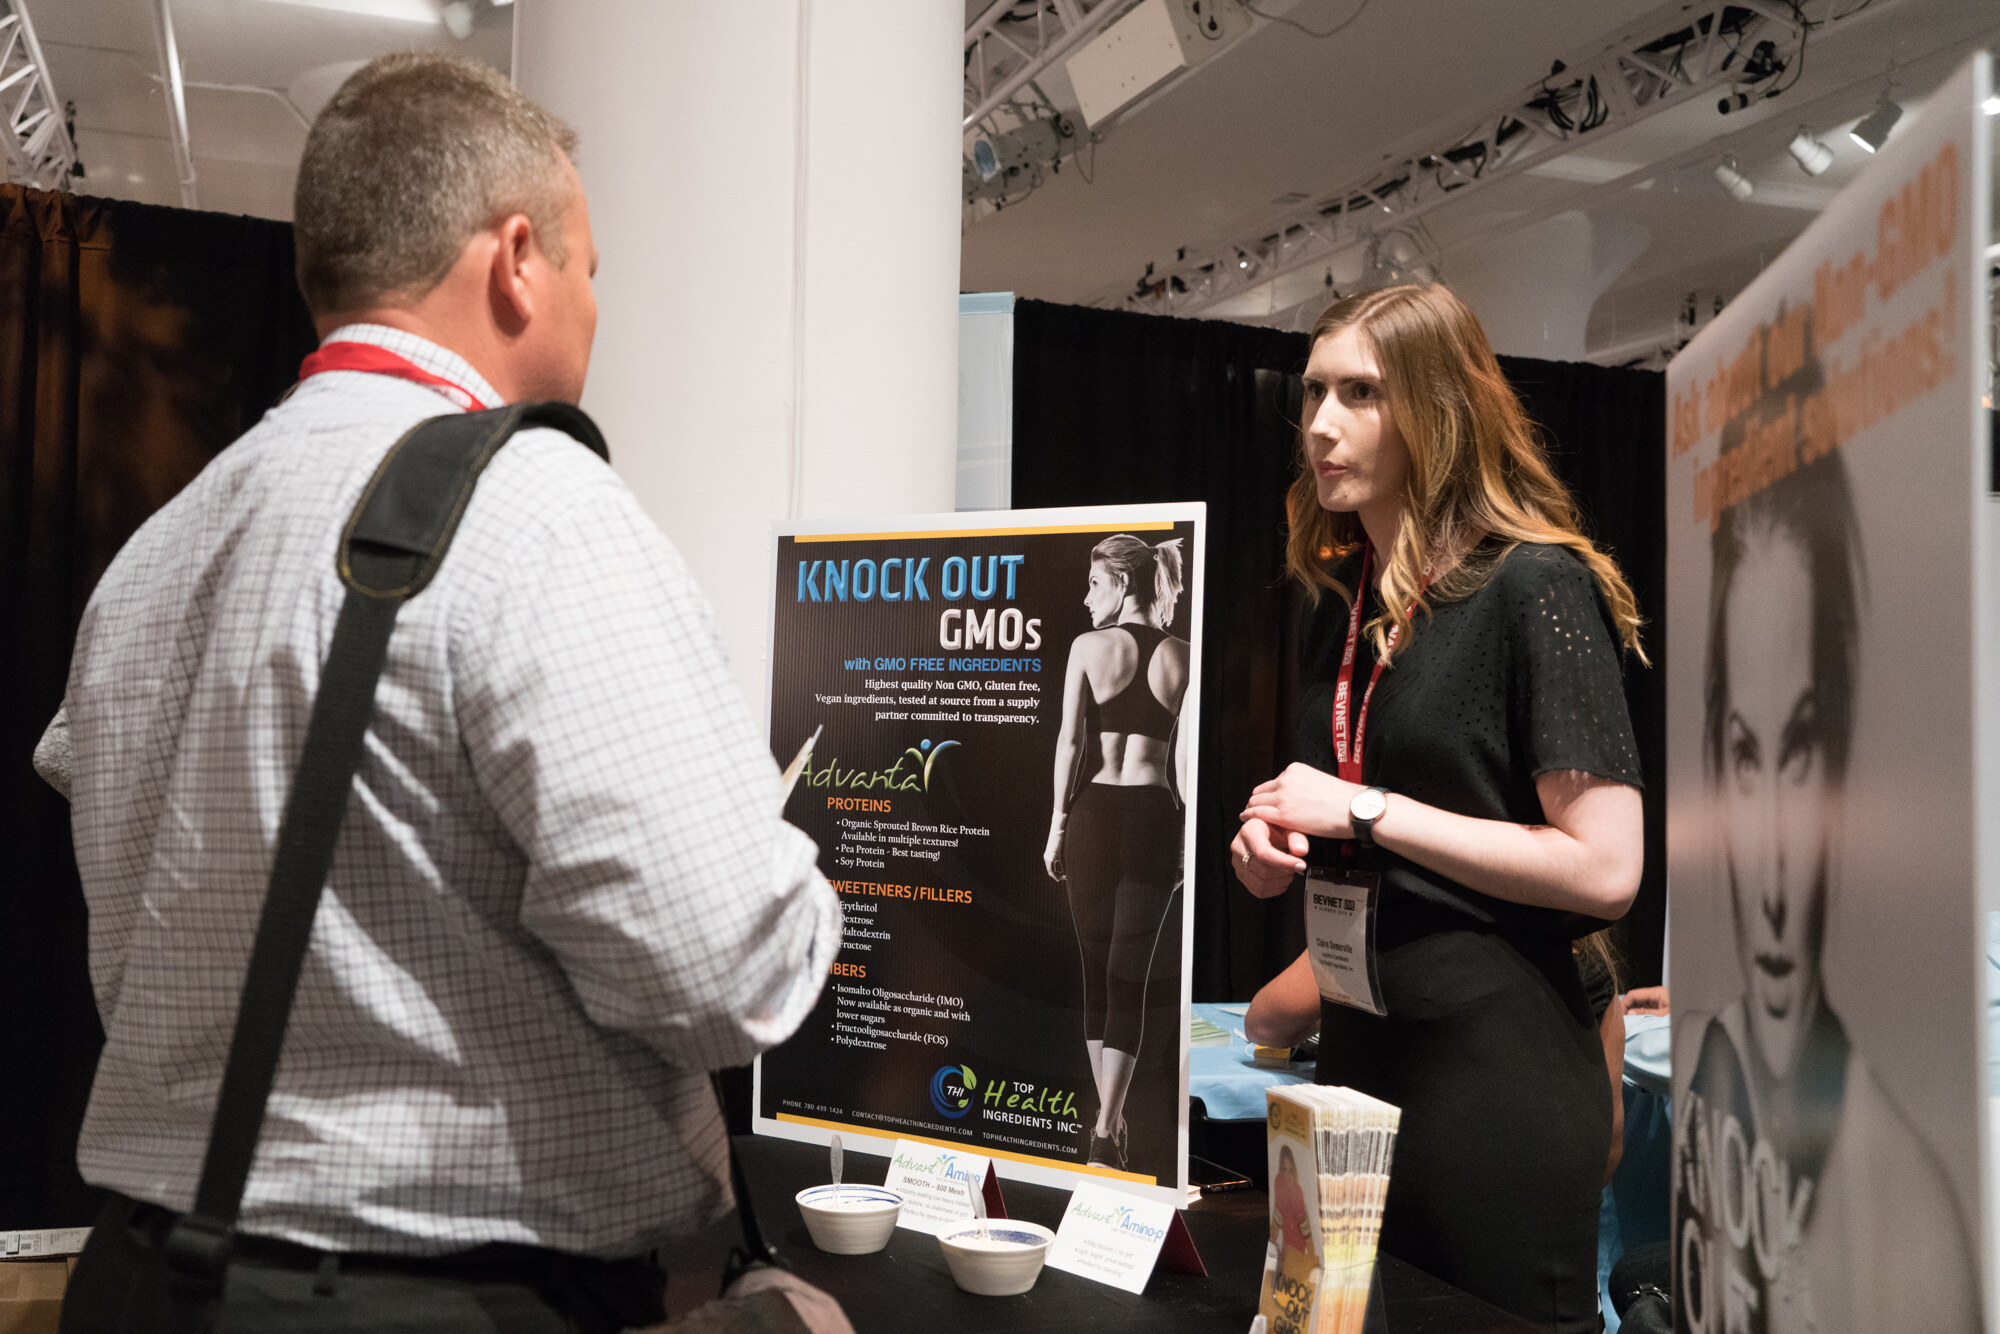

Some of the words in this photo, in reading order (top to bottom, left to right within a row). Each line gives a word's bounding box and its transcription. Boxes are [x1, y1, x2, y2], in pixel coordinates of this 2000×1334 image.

[798, 557, 931, 603] KNOCK
[942, 555, 1025, 601] OUT
[940, 608, 1042, 650] GMOs
[844, 657, 871, 671] with
[874, 657, 906, 671] GMO
[910, 657, 945, 671] FREE
[949, 658, 1042, 672] INGREDIENTS
[864, 679, 899, 691] Highest
[901, 679, 933, 692] quality
[935, 680, 955, 690] Non
[956, 680, 982, 692] GMO,
[984, 680, 1016, 691] Gluten
[1018, 681, 1041, 692] free,
[815, 693, 842, 705] Vegan
[844, 693, 897, 706] ingredients,
[898, 695, 926, 705] tested
[928, 696, 938, 705] at
[940, 697, 971, 706] source
[973, 695, 997, 706] from
[998, 698, 1005, 707] a
[1006, 697, 1040, 709] supply
[875, 711, 909, 721] partner
[910, 711, 960, 721] committed
[962, 712, 972, 722] to
[974, 713, 1040, 725] transparency.
[1335, 680, 1348, 740] BEVNET
[827, 797, 892, 813] PROTEINS
[841, 818, 872, 831] Organic
[873, 820, 910, 832] Sprouted
[911, 822, 938, 833] Brown
[939, 824, 958, 834] Rice
[959, 825, 990, 836] Protein
[841, 831, 877, 842] Available
[878, 833, 887, 842] in
[888, 834, 922, 846] multiple
[922, 837, 959, 848] textures!
[840, 844, 855, 853] Pea
[856, 845, 885, 855] Protein
[892, 847, 909, 857] Best
[910, 850, 940, 861] tasting!
[840, 857, 854, 868] Soy
[856, 858, 885, 869] Protein
[840, 900, 878, 912] Erythritol
[1313, 893, 1343, 909] BEVNET
[839, 940, 872, 951] Fructose
[829, 962, 867, 978] IBERS
[837, 983, 871, 995] Isomalto
[872, 987, 935, 1004] Oligosaccharide
[936, 995, 964, 1009] (IMO)
[836, 996, 857, 1007] Now
[857, 999, 892, 1011] available
[893, 1005, 902, 1013] as
[903, 1006, 933, 1017] organic
[934, 1009, 949, 1019] and
[951, 1011, 970, 1021] with
[836, 1009, 859, 1020] lower
[860, 1013, 886, 1024] sugars
[836, 1022, 922, 1042] Fructooligosaccharide
[923, 1033, 949, 1048] (FOS)
[836, 1035, 887, 1050] Polydextrose
[947, 1085, 965, 1097] THI
[1013, 1081, 1035, 1094] TOP
[984, 1079, 1078, 1119] Health
[782, 1099, 802, 1109] PHONE
[829, 1106, 843, 1115] 1424
[851, 1110, 973, 1137] CONTACT@TOPHEALTHINGREDIENTS.COM
[982, 1108, 1052, 1130] INGREDIENTS
[982, 1132, 1078, 1154] TOPHEALTHINGREDIENTS.COM
[902, 1176, 931, 1189] SMOOTH
[948, 1187, 965, 1196] Mesh
